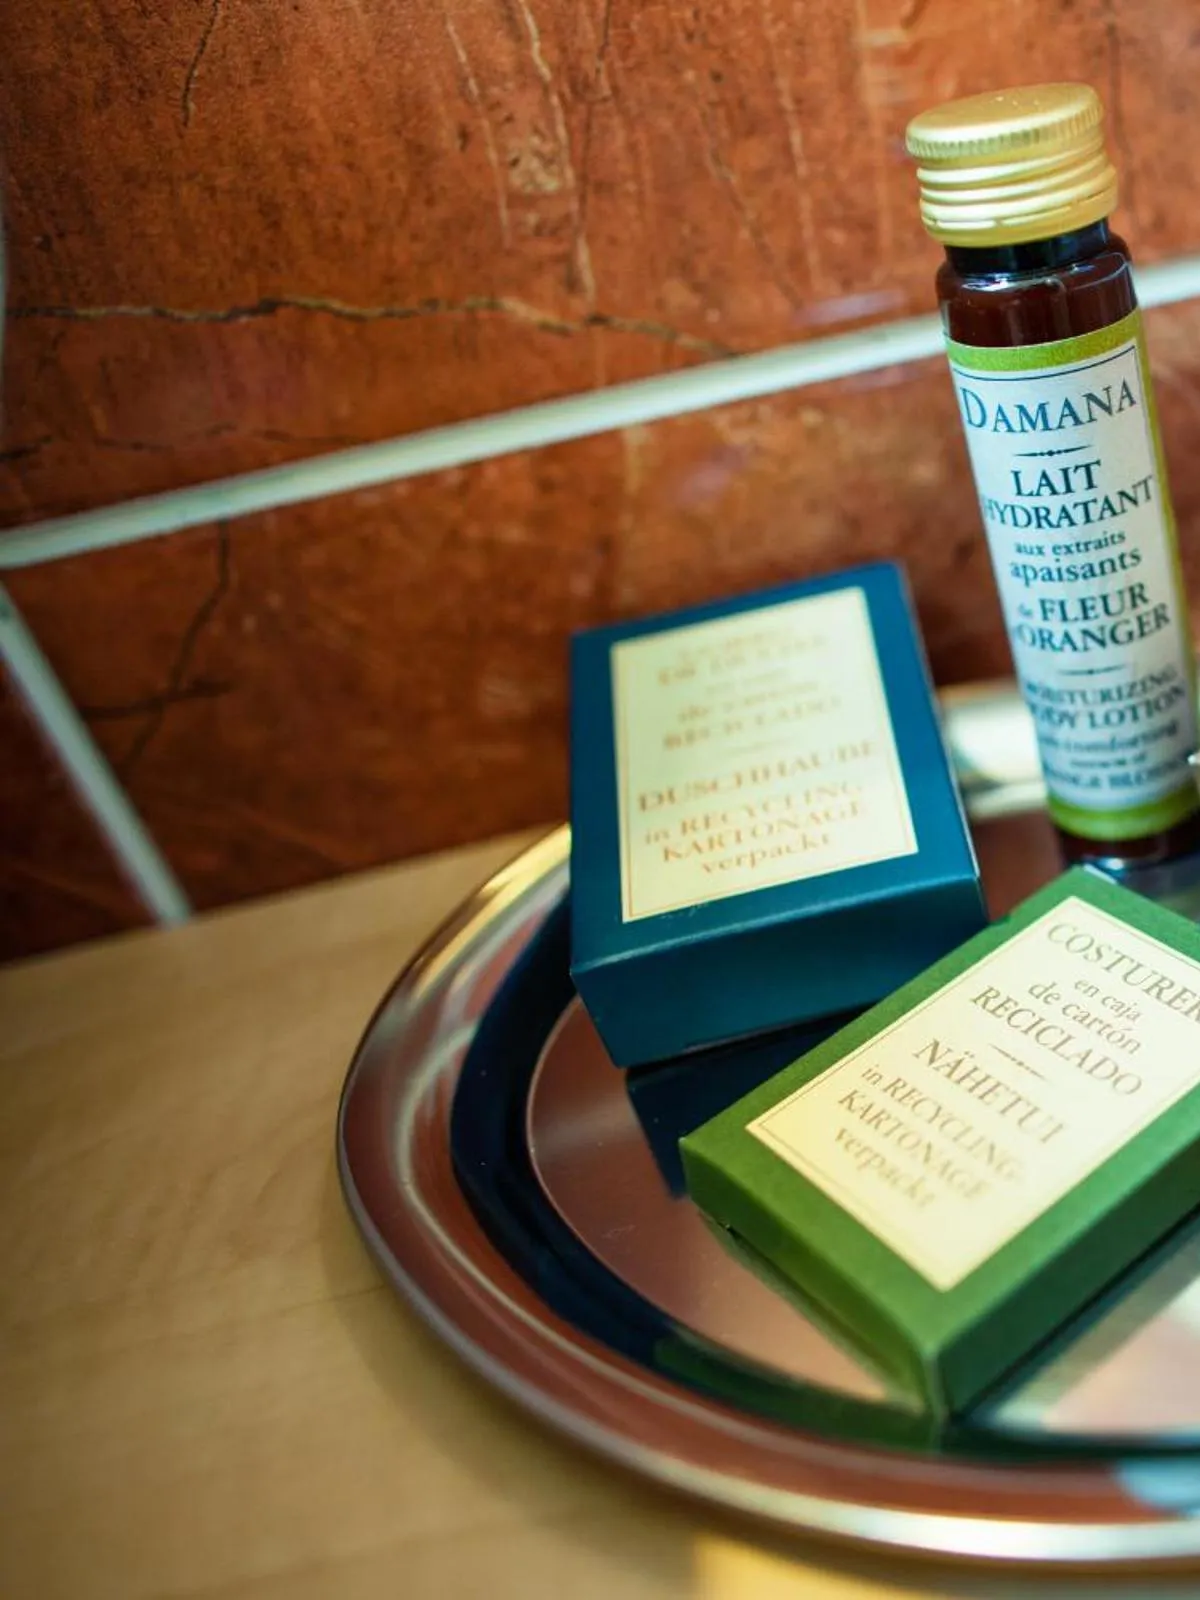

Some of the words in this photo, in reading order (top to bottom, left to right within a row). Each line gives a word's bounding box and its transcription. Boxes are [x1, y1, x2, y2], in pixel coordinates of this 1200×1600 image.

[959, 376, 1138, 434] DAMANA
[1010, 459, 1102, 498] LAIT
[1013, 541, 1046, 557] aux
[1051, 530, 1127, 556] extraits
[1009, 548, 1143, 588] apaisants
[1039, 581, 1149, 623] FLEUR
[700, 831, 830, 874] verpackt
[1026, 980, 1061, 1006] de
[1060, 1002, 1141, 1056] cartón
[1072, 979, 1100, 999] en
[1099, 995, 1142, 1023] caja
[967, 984, 1143, 1096] RECICLADO
[859, 1063, 884, 1086] in
[911, 1036, 1064, 1145] NÄHETUI
[836, 1088, 989, 1200] KARTONAGE
[833, 1126, 935, 1207] verpackt
